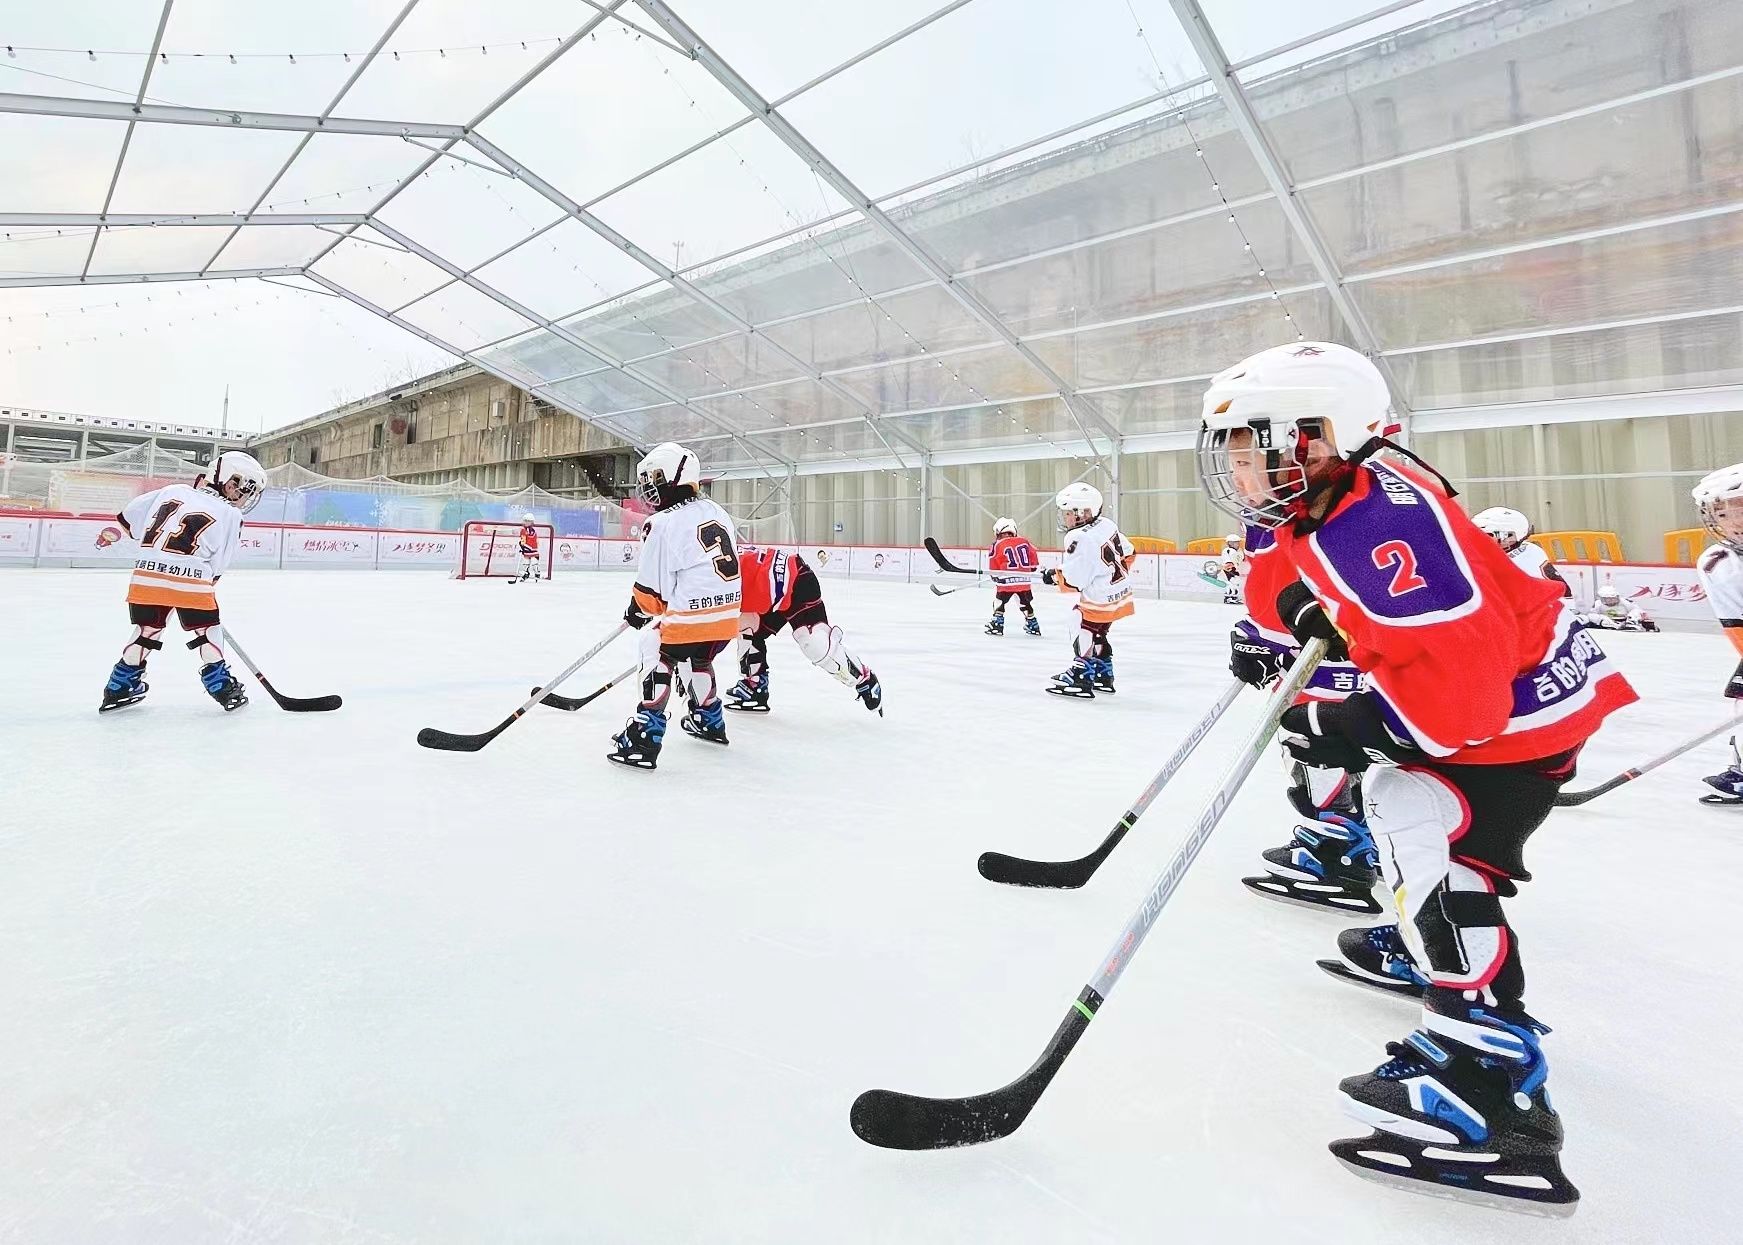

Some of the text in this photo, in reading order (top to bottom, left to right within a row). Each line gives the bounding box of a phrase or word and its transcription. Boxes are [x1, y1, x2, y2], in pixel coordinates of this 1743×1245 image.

[141, 499, 216, 556] 11
[697, 520, 741, 582] 3
[1003, 543, 1031, 569] 10
[1371, 539, 1428, 598] 2
